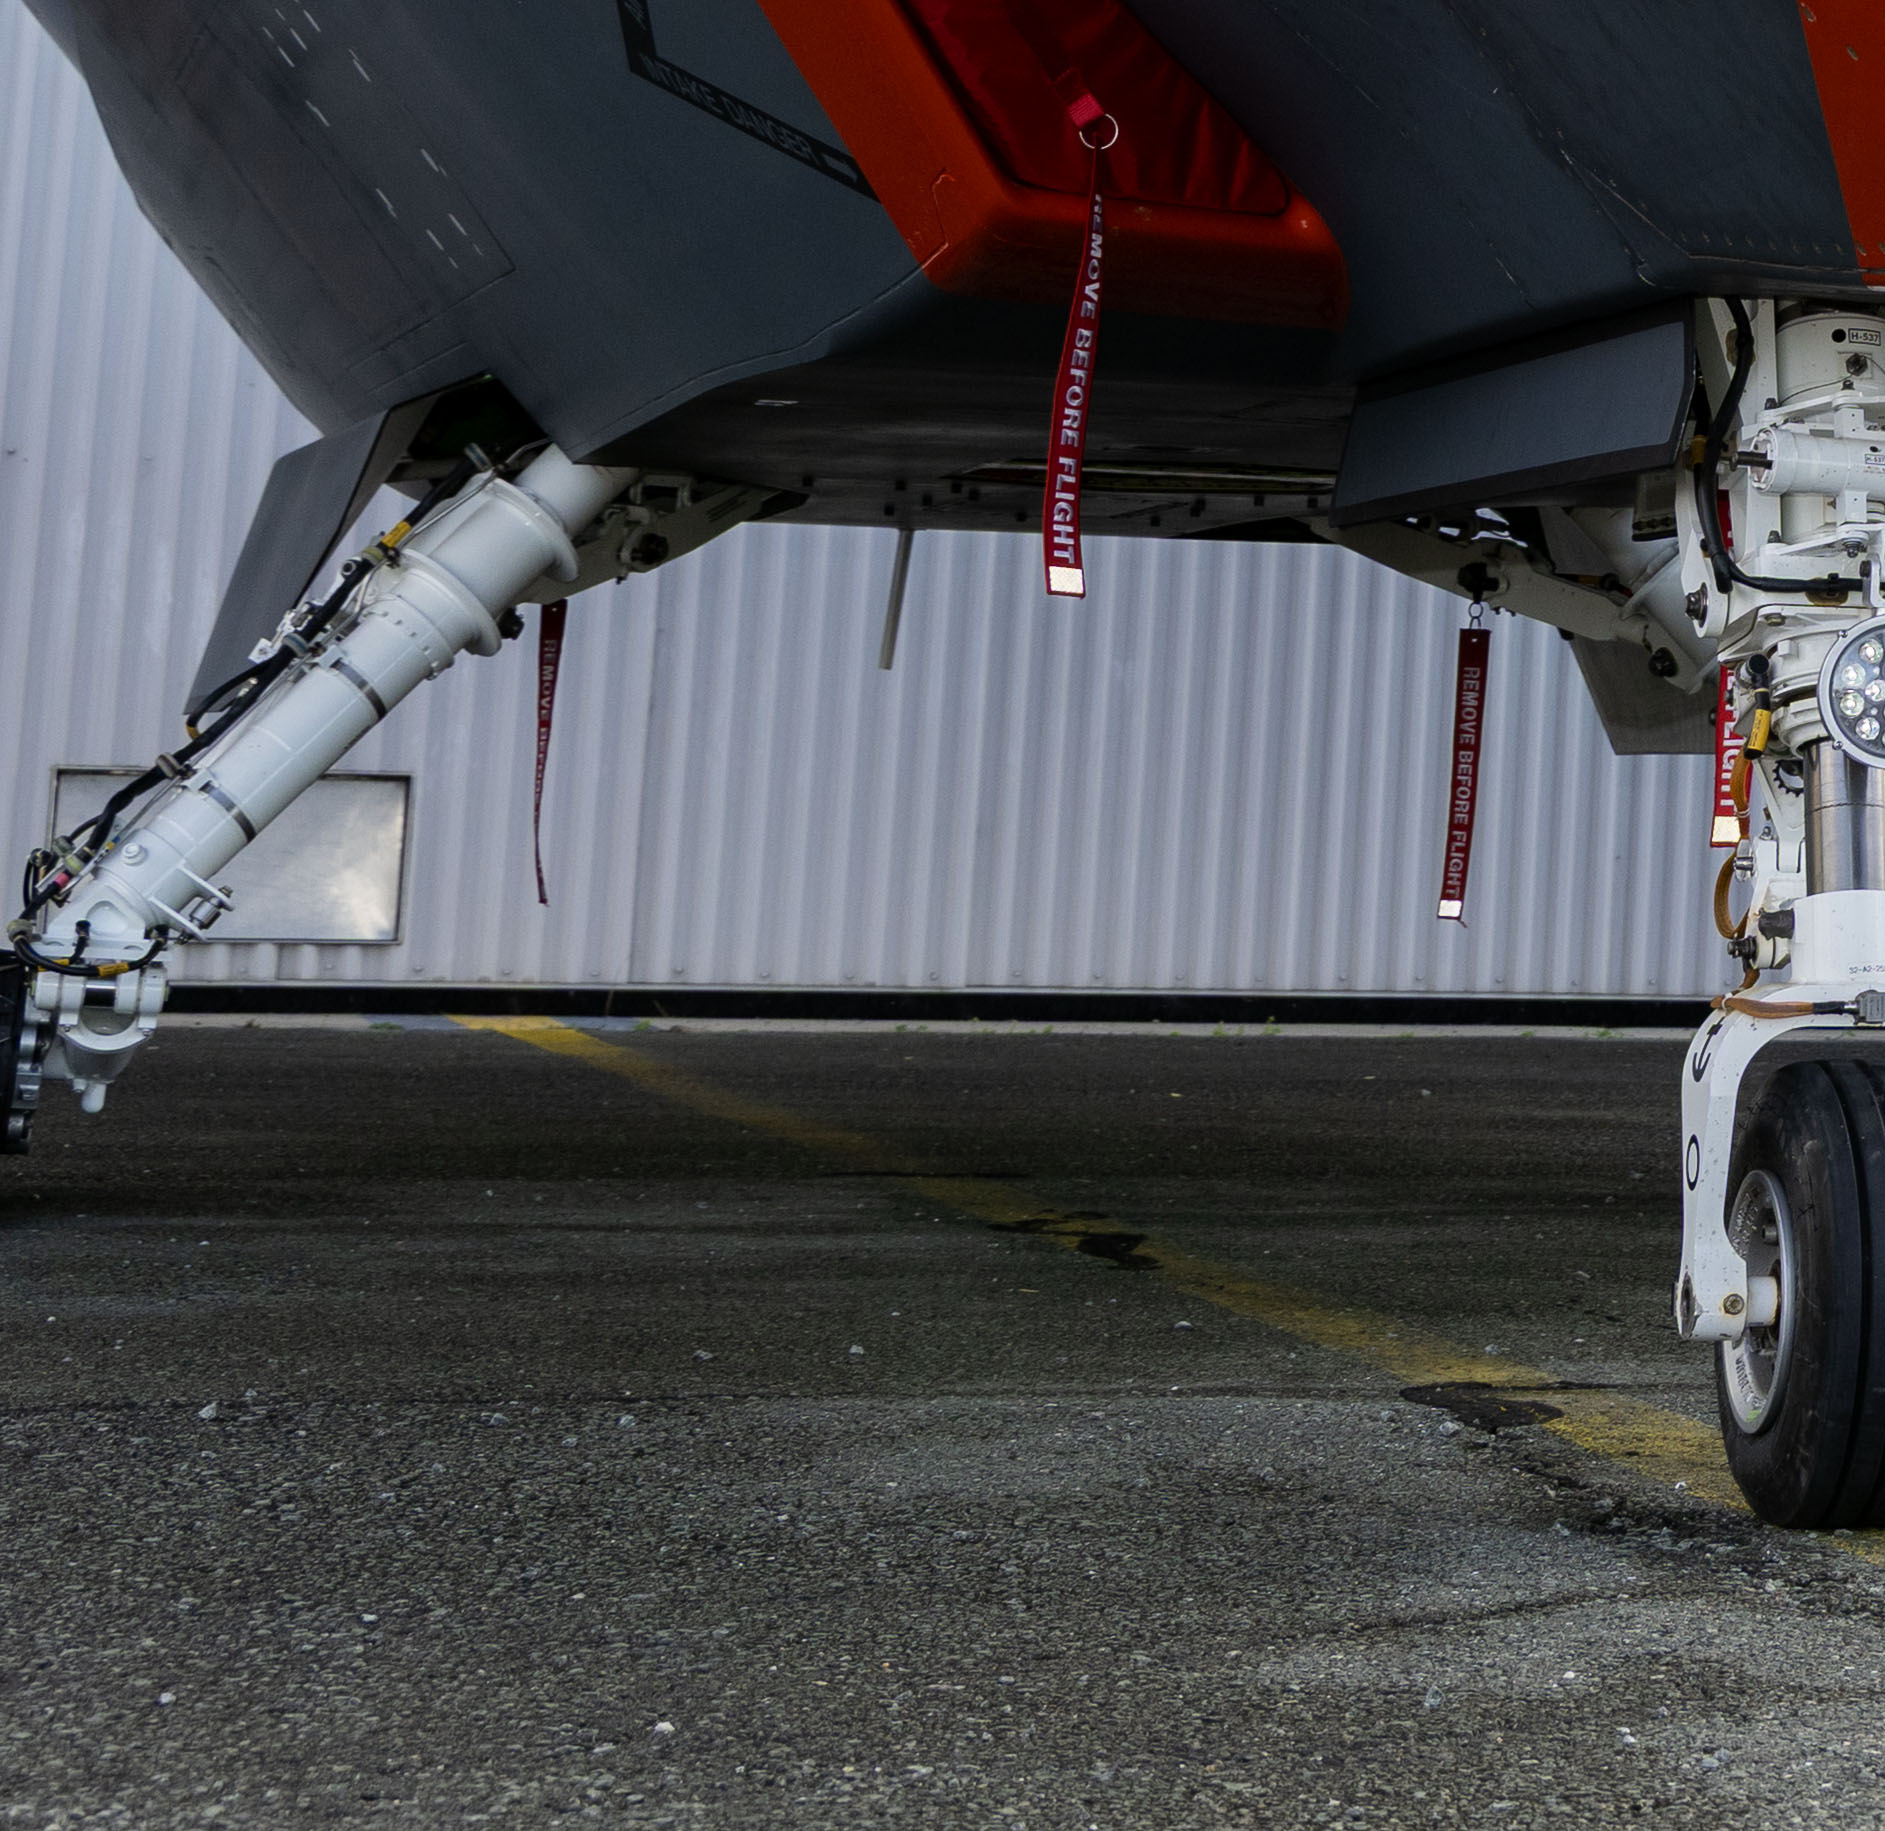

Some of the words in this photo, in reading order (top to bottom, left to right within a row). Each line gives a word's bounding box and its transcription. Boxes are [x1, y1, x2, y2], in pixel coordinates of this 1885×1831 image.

[638, 52, 724, 116] INTAKE
[720, 106, 822, 178] DANGER
[1080, 192, 1103, 320] REMOVE
[1851, 331, 1879, 343] H-537
[1059, 328, 1094, 448] BEFORE
[1051, 457, 1078, 565] FLIGHT
[541, 639, 557, 721] REMOVE
[1459, 665, 1481, 746] REMOVE
[1453, 750, 1475, 825] BEFORE
[1444, 830, 1470, 898] FLIGHT
